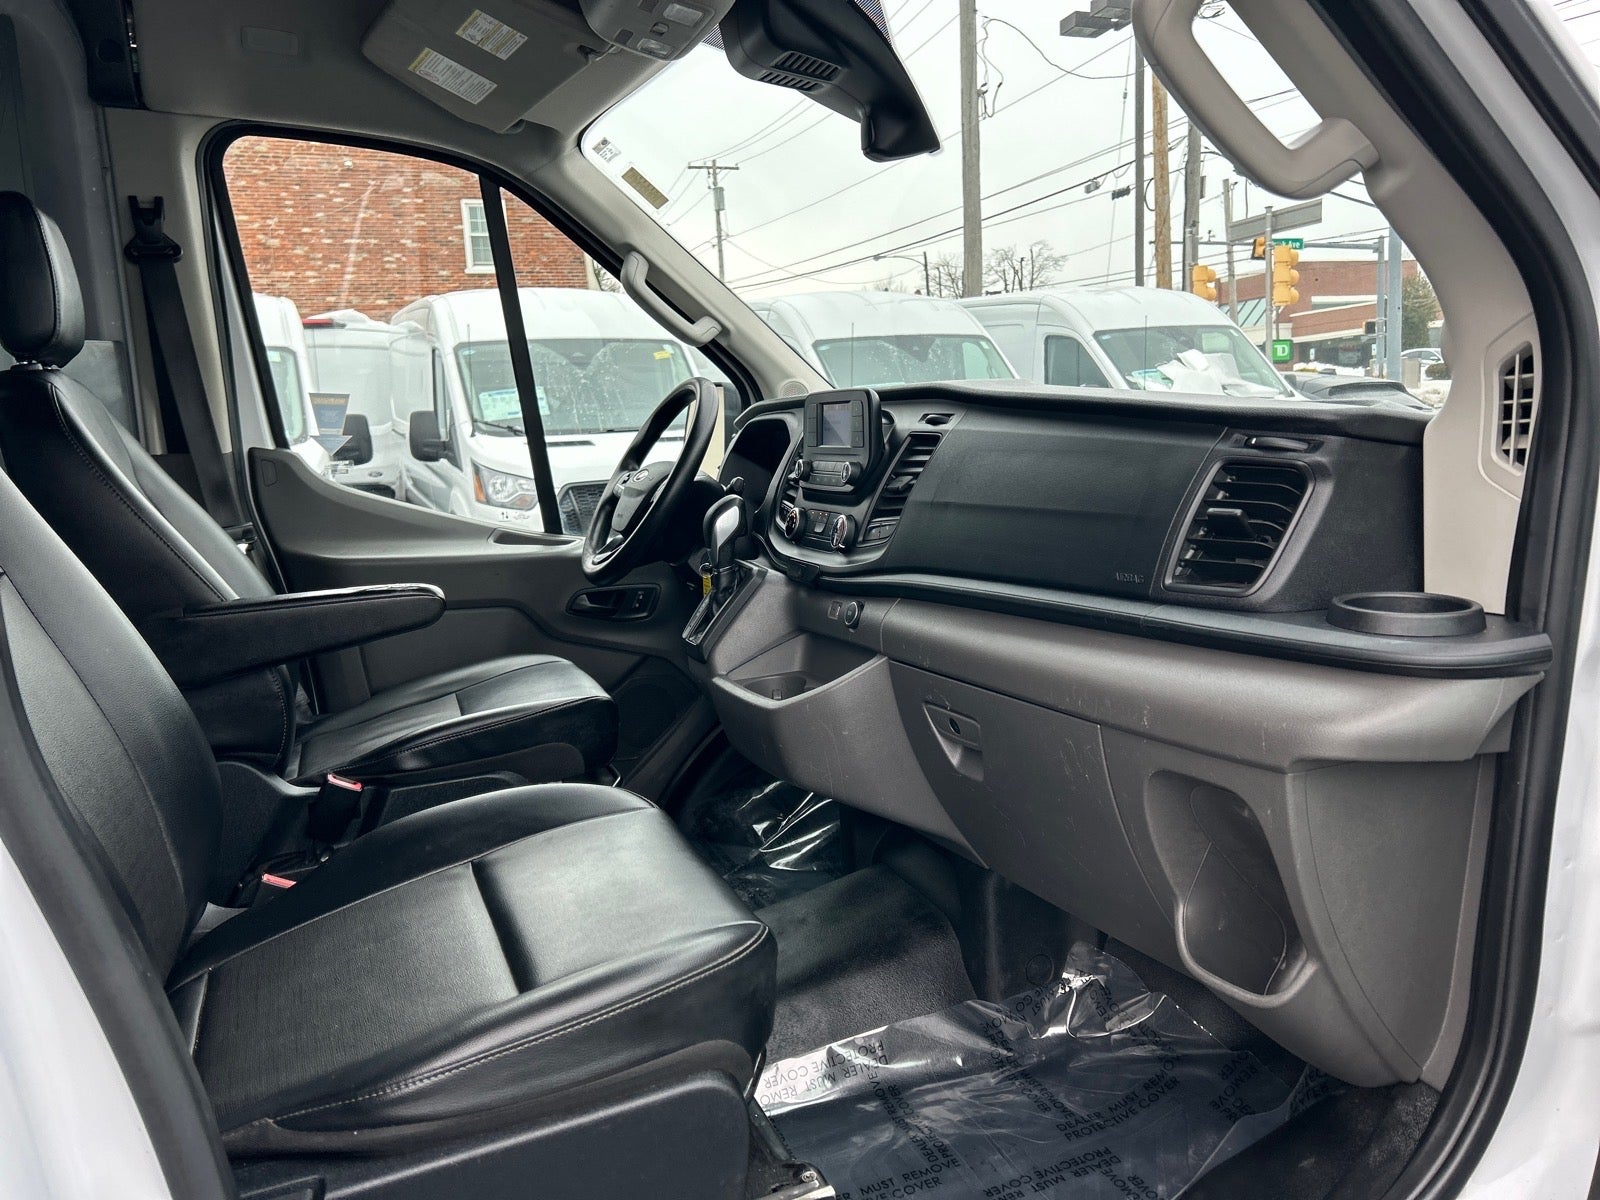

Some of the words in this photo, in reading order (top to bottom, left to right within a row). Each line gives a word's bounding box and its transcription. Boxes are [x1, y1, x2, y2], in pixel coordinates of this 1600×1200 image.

[1274, 344, 1289, 357] TD
[813, 1039, 884, 1074] PROTECTIVE
[843, 1054, 889, 1079] DEALER
[763, 1067, 810, 1090] COVER
[803, 1073, 837, 1094] MUST
[760, 1084, 798, 1107] REMO
[1056, 1112, 1104, 1133] DEALER
[1108, 1089, 1140, 1116] MUST
[1064, 1104, 1137, 1142] PROTECTIVE
[1139, 1075, 1181, 1109] COVER
[1036, 1146, 1112, 1181] PROTECTIVE
[1073, 1155, 1122, 1178] DEALER
[859, 1176, 897, 1196] MUST
[901, 1156, 962, 1182] REMOVE
[891, 1176, 943, 1198] COVER
[983, 1174, 1033, 1198] COVER
[1032, 1175, 1066, 1194] MUST
[1102, 1169, 1140, 1200] EMOVE
[1127, 1174, 1159, 1200] OVER
